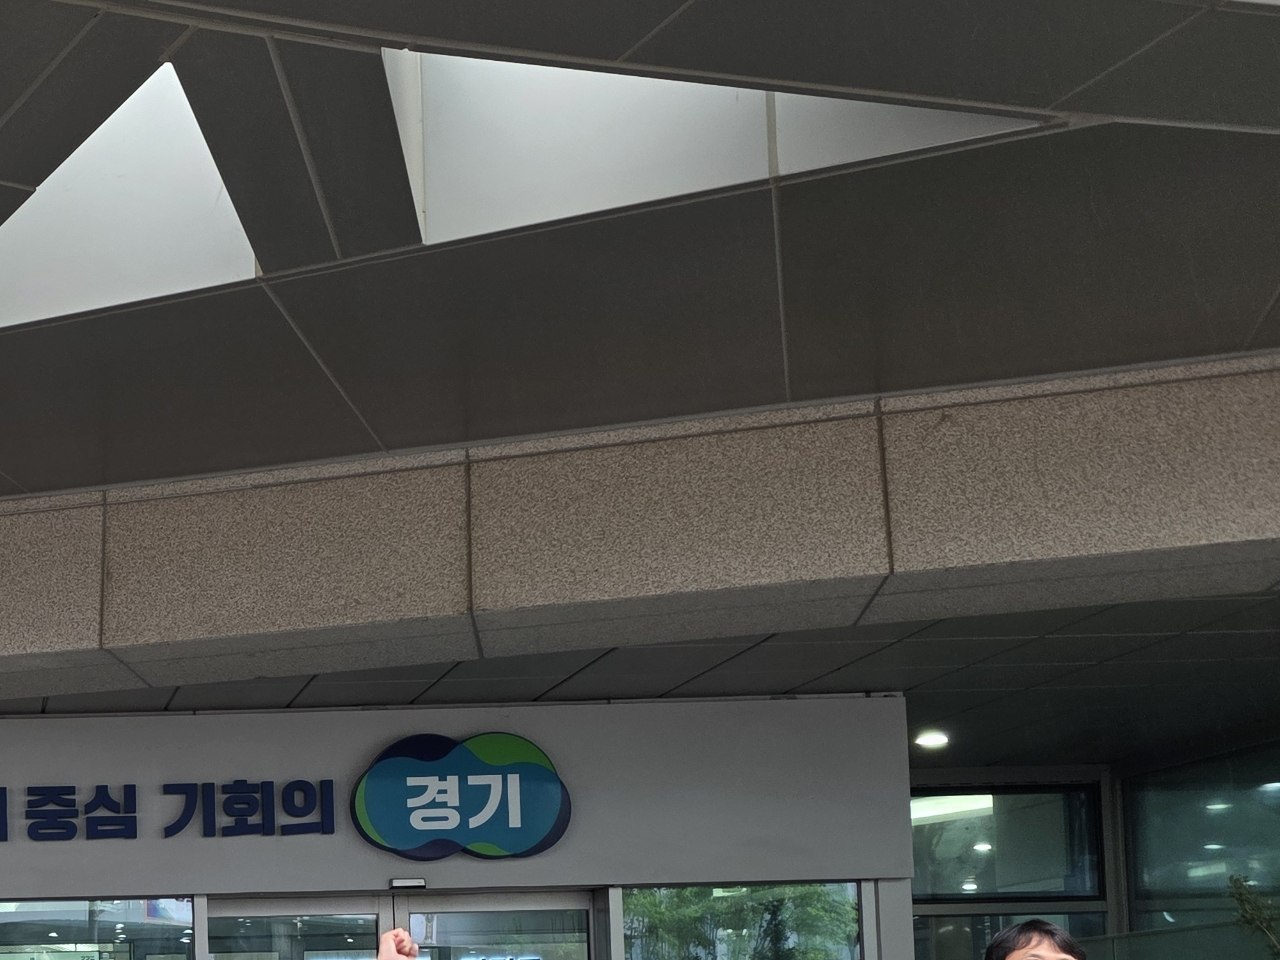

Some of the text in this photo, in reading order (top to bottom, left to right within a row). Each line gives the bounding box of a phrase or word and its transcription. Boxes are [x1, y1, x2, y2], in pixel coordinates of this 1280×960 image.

[25, 784, 139, 841] 중심
[160, 778, 335, 840] 기회의
[405, 773, 523, 831] 경기
